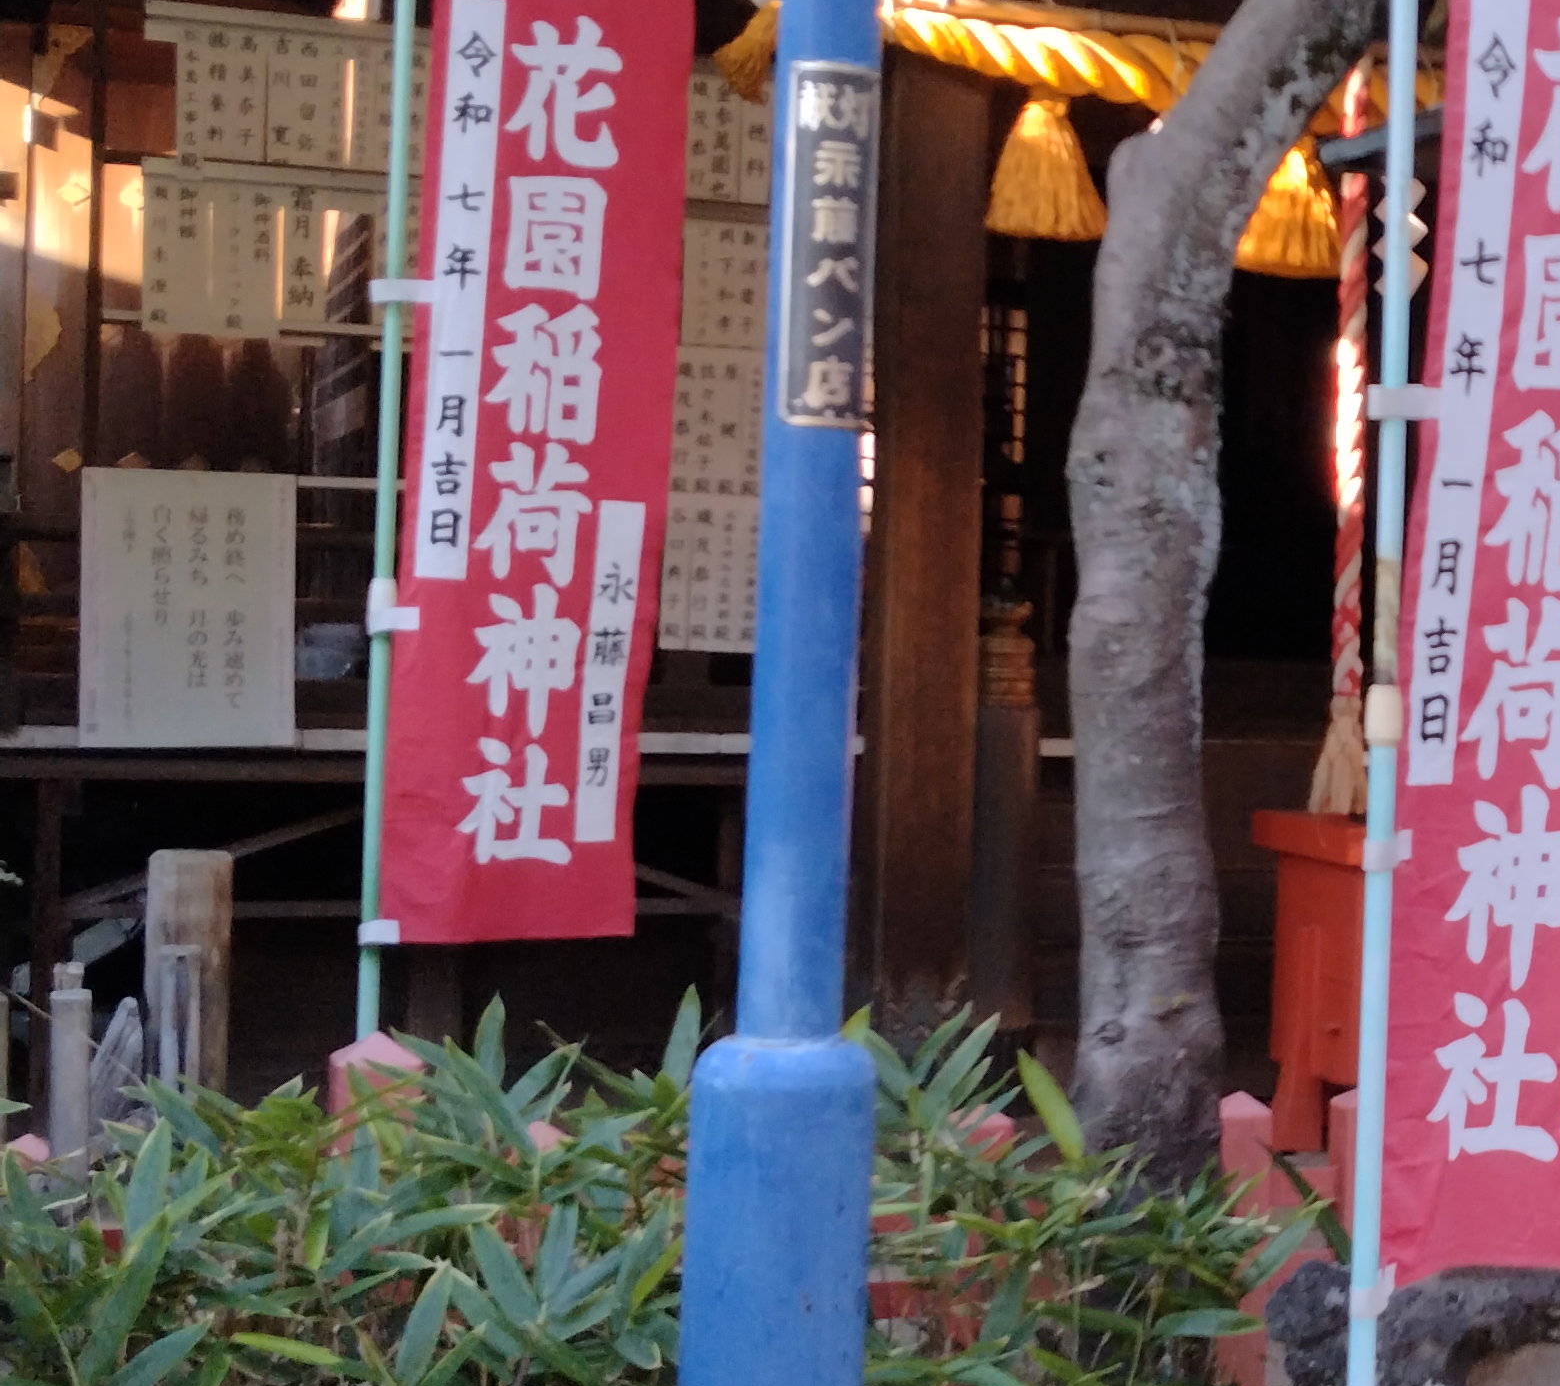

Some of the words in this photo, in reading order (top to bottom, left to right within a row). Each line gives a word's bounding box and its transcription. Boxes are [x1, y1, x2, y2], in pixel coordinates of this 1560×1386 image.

[457, 16, 623, 865] 花園稲荷神社
[586, 562, 635, 788] 永藤昌男
